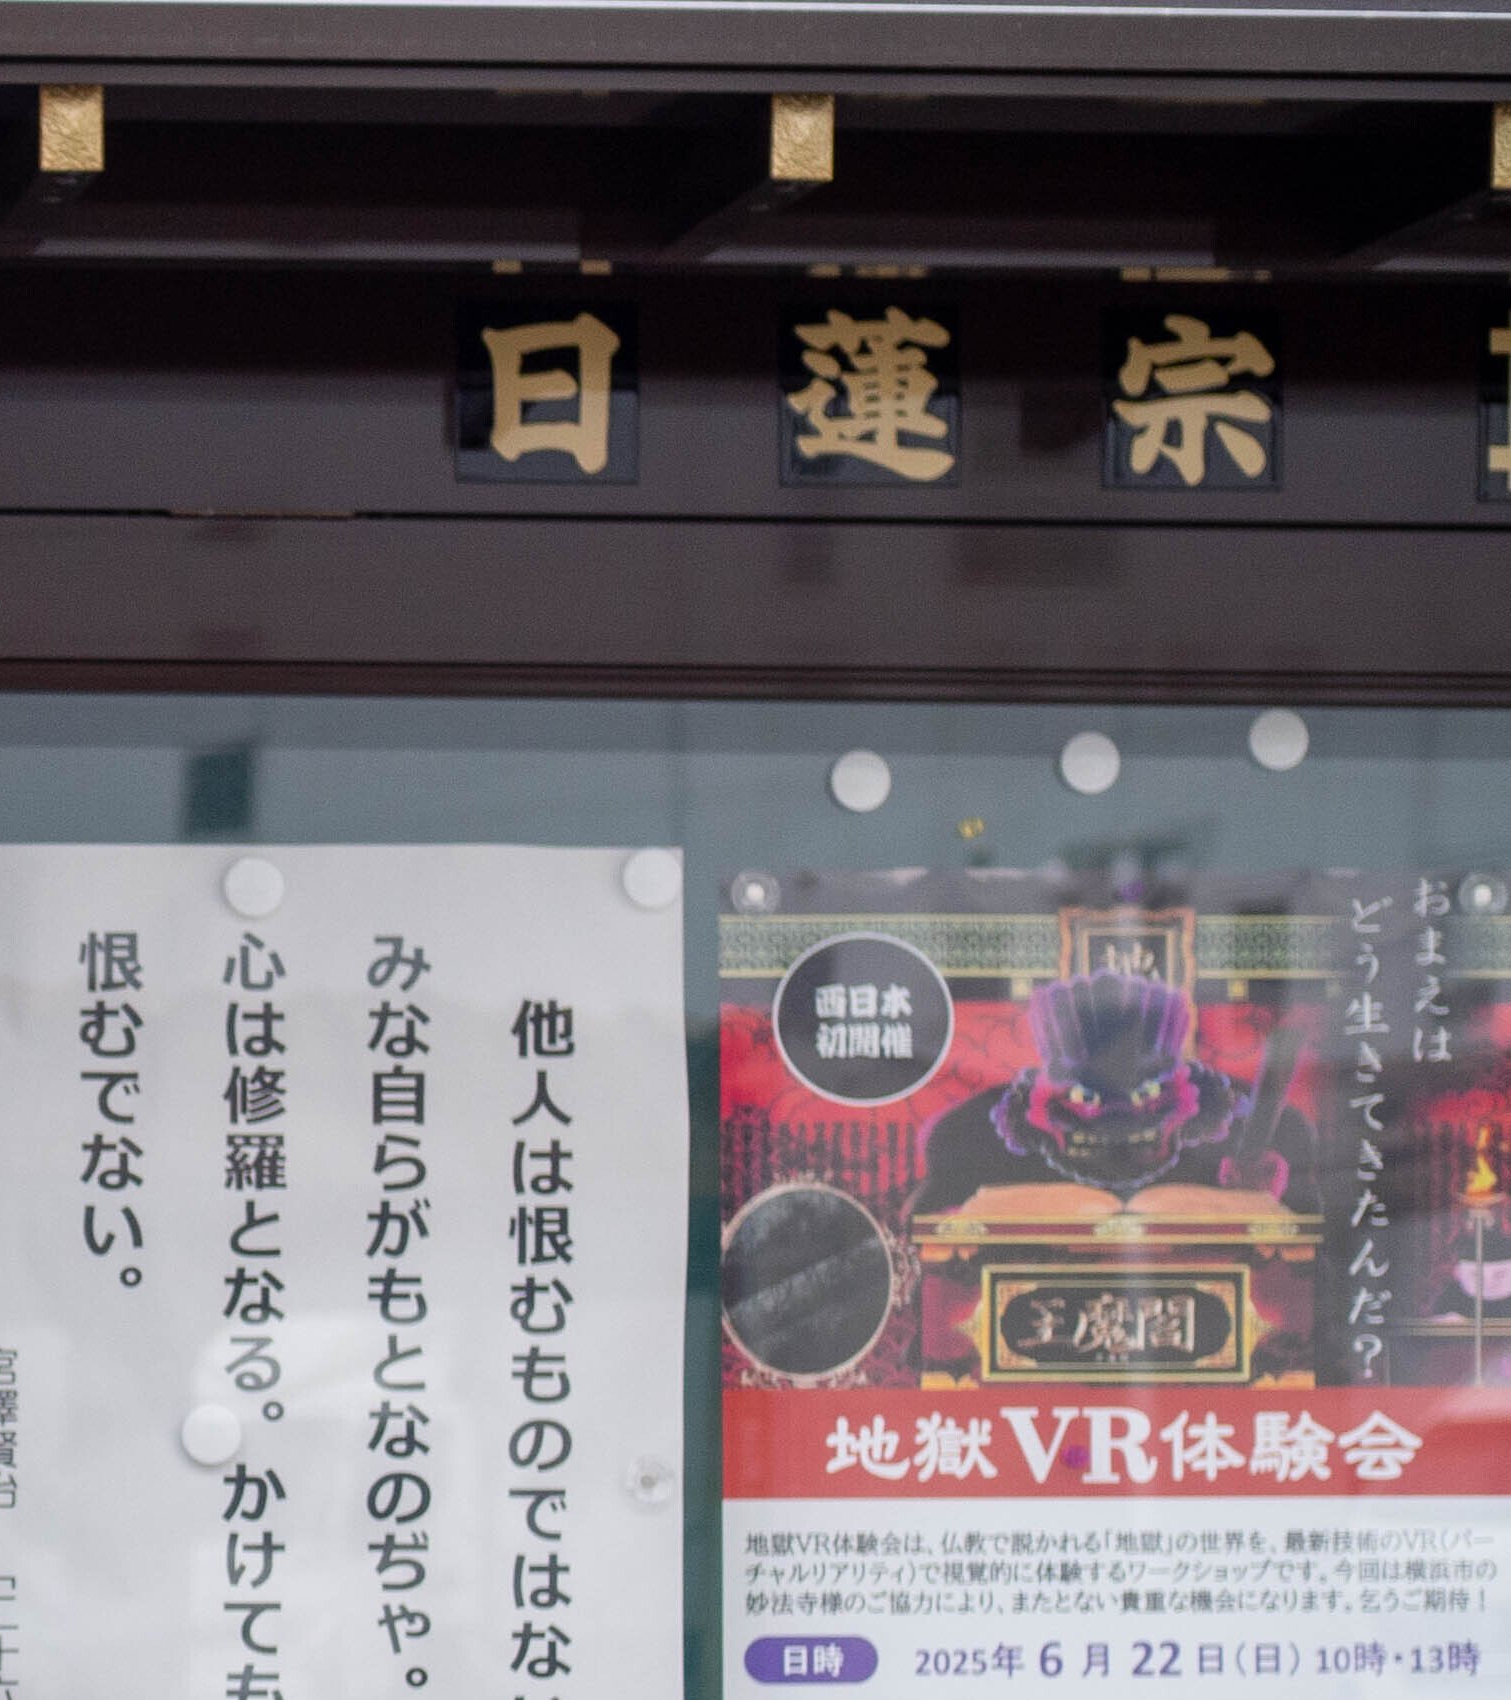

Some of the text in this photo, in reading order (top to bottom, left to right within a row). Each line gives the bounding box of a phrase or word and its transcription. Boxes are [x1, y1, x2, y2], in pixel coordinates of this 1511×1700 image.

[814, 983, 913, 1019] 西日本
[1412, 877, 1452, 1063] おまえは
[815, 1023, 914, 1059] 初開催
[78, 930, 145, 1289] 恨むでない。
[1344, 895, 1394, 1379] どう生きてきたんだ？
[825, 1405, 1425, 1486] 地獄VR体験会
[781, 1642, 845, 1678] 日時
